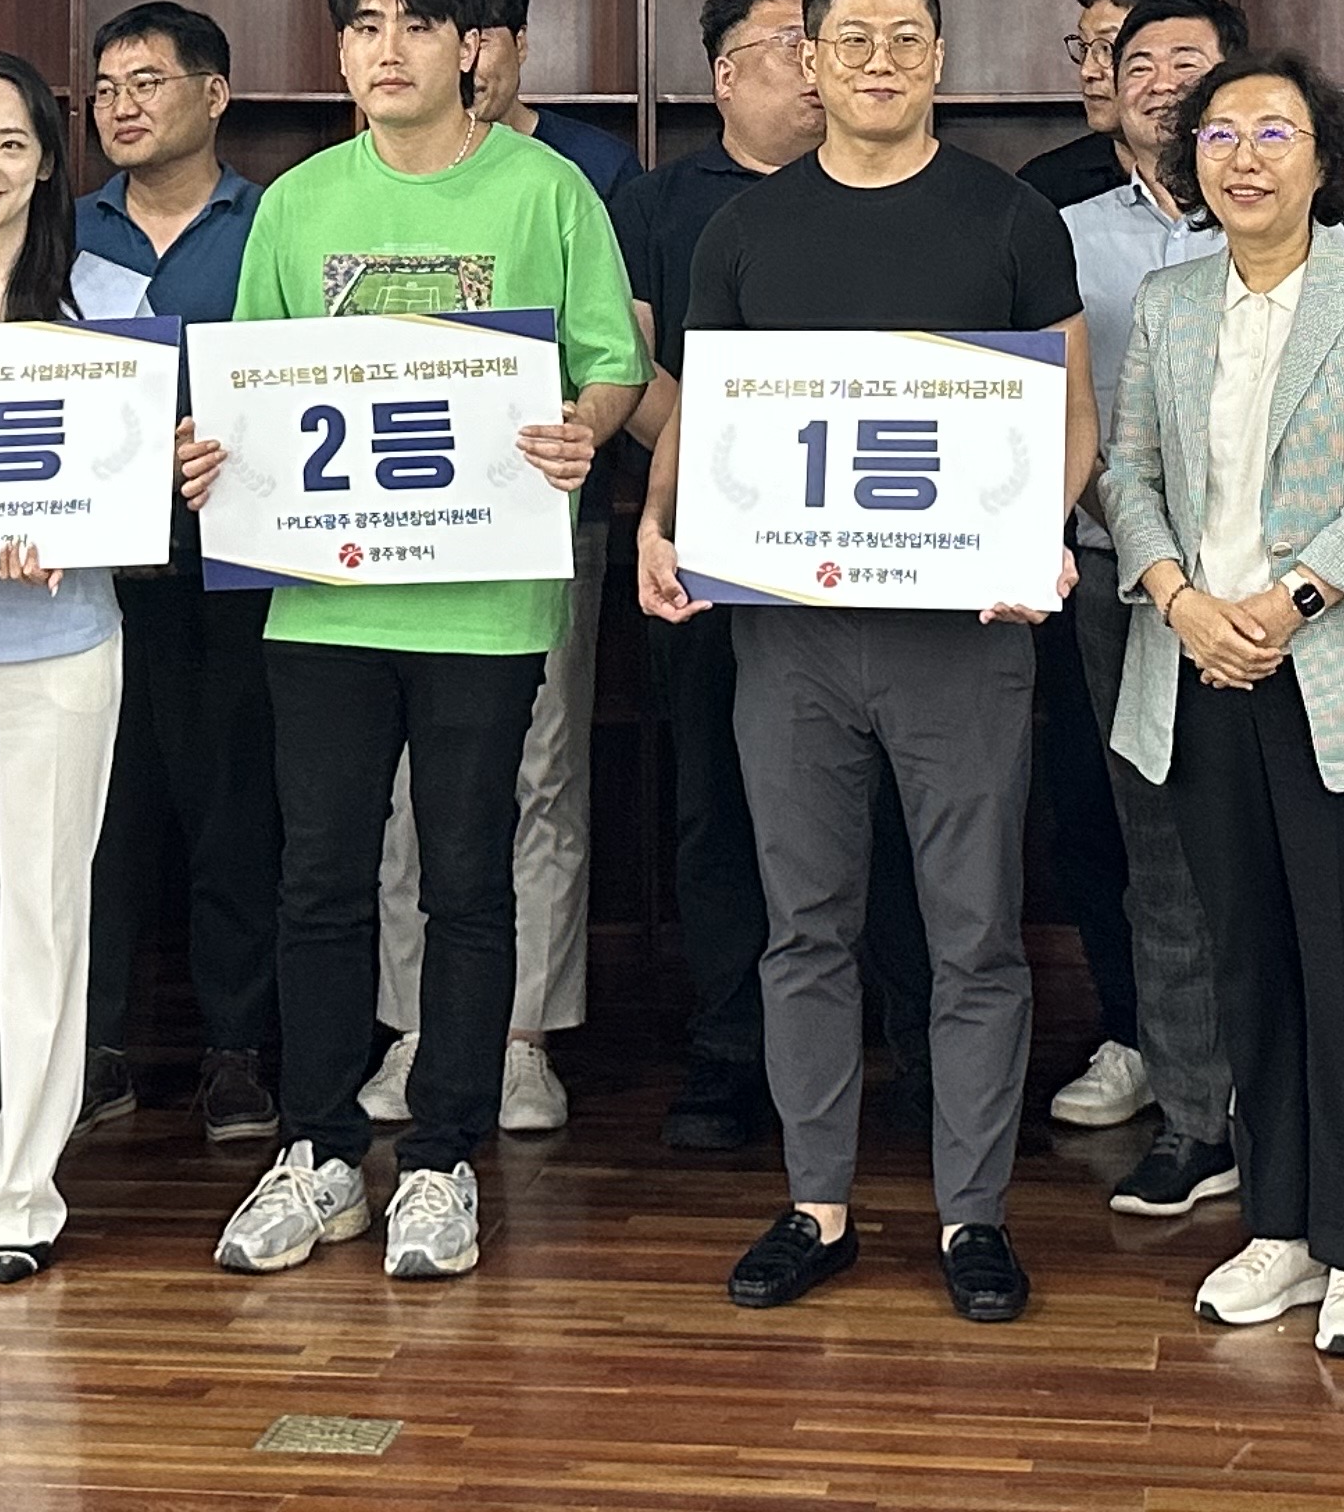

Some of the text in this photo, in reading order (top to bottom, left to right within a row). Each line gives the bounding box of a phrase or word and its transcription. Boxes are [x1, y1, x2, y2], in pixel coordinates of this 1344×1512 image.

[20, 360, 137, 382] 사업화자금지원
[231, 356, 518, 389] 입주스타트업 기술고도 사업화자금지원
[725, 378, 1022, 399] 입주스타트업 기술고도 사업화자금지원
[277, 507, 491, 530] I-PLEX광주 광주청년창업지원센터
[756, 531, 979, 550] I-PLEX광주 광주청년창업지원센터
[369, 545, 434, 562] 광주광역시
